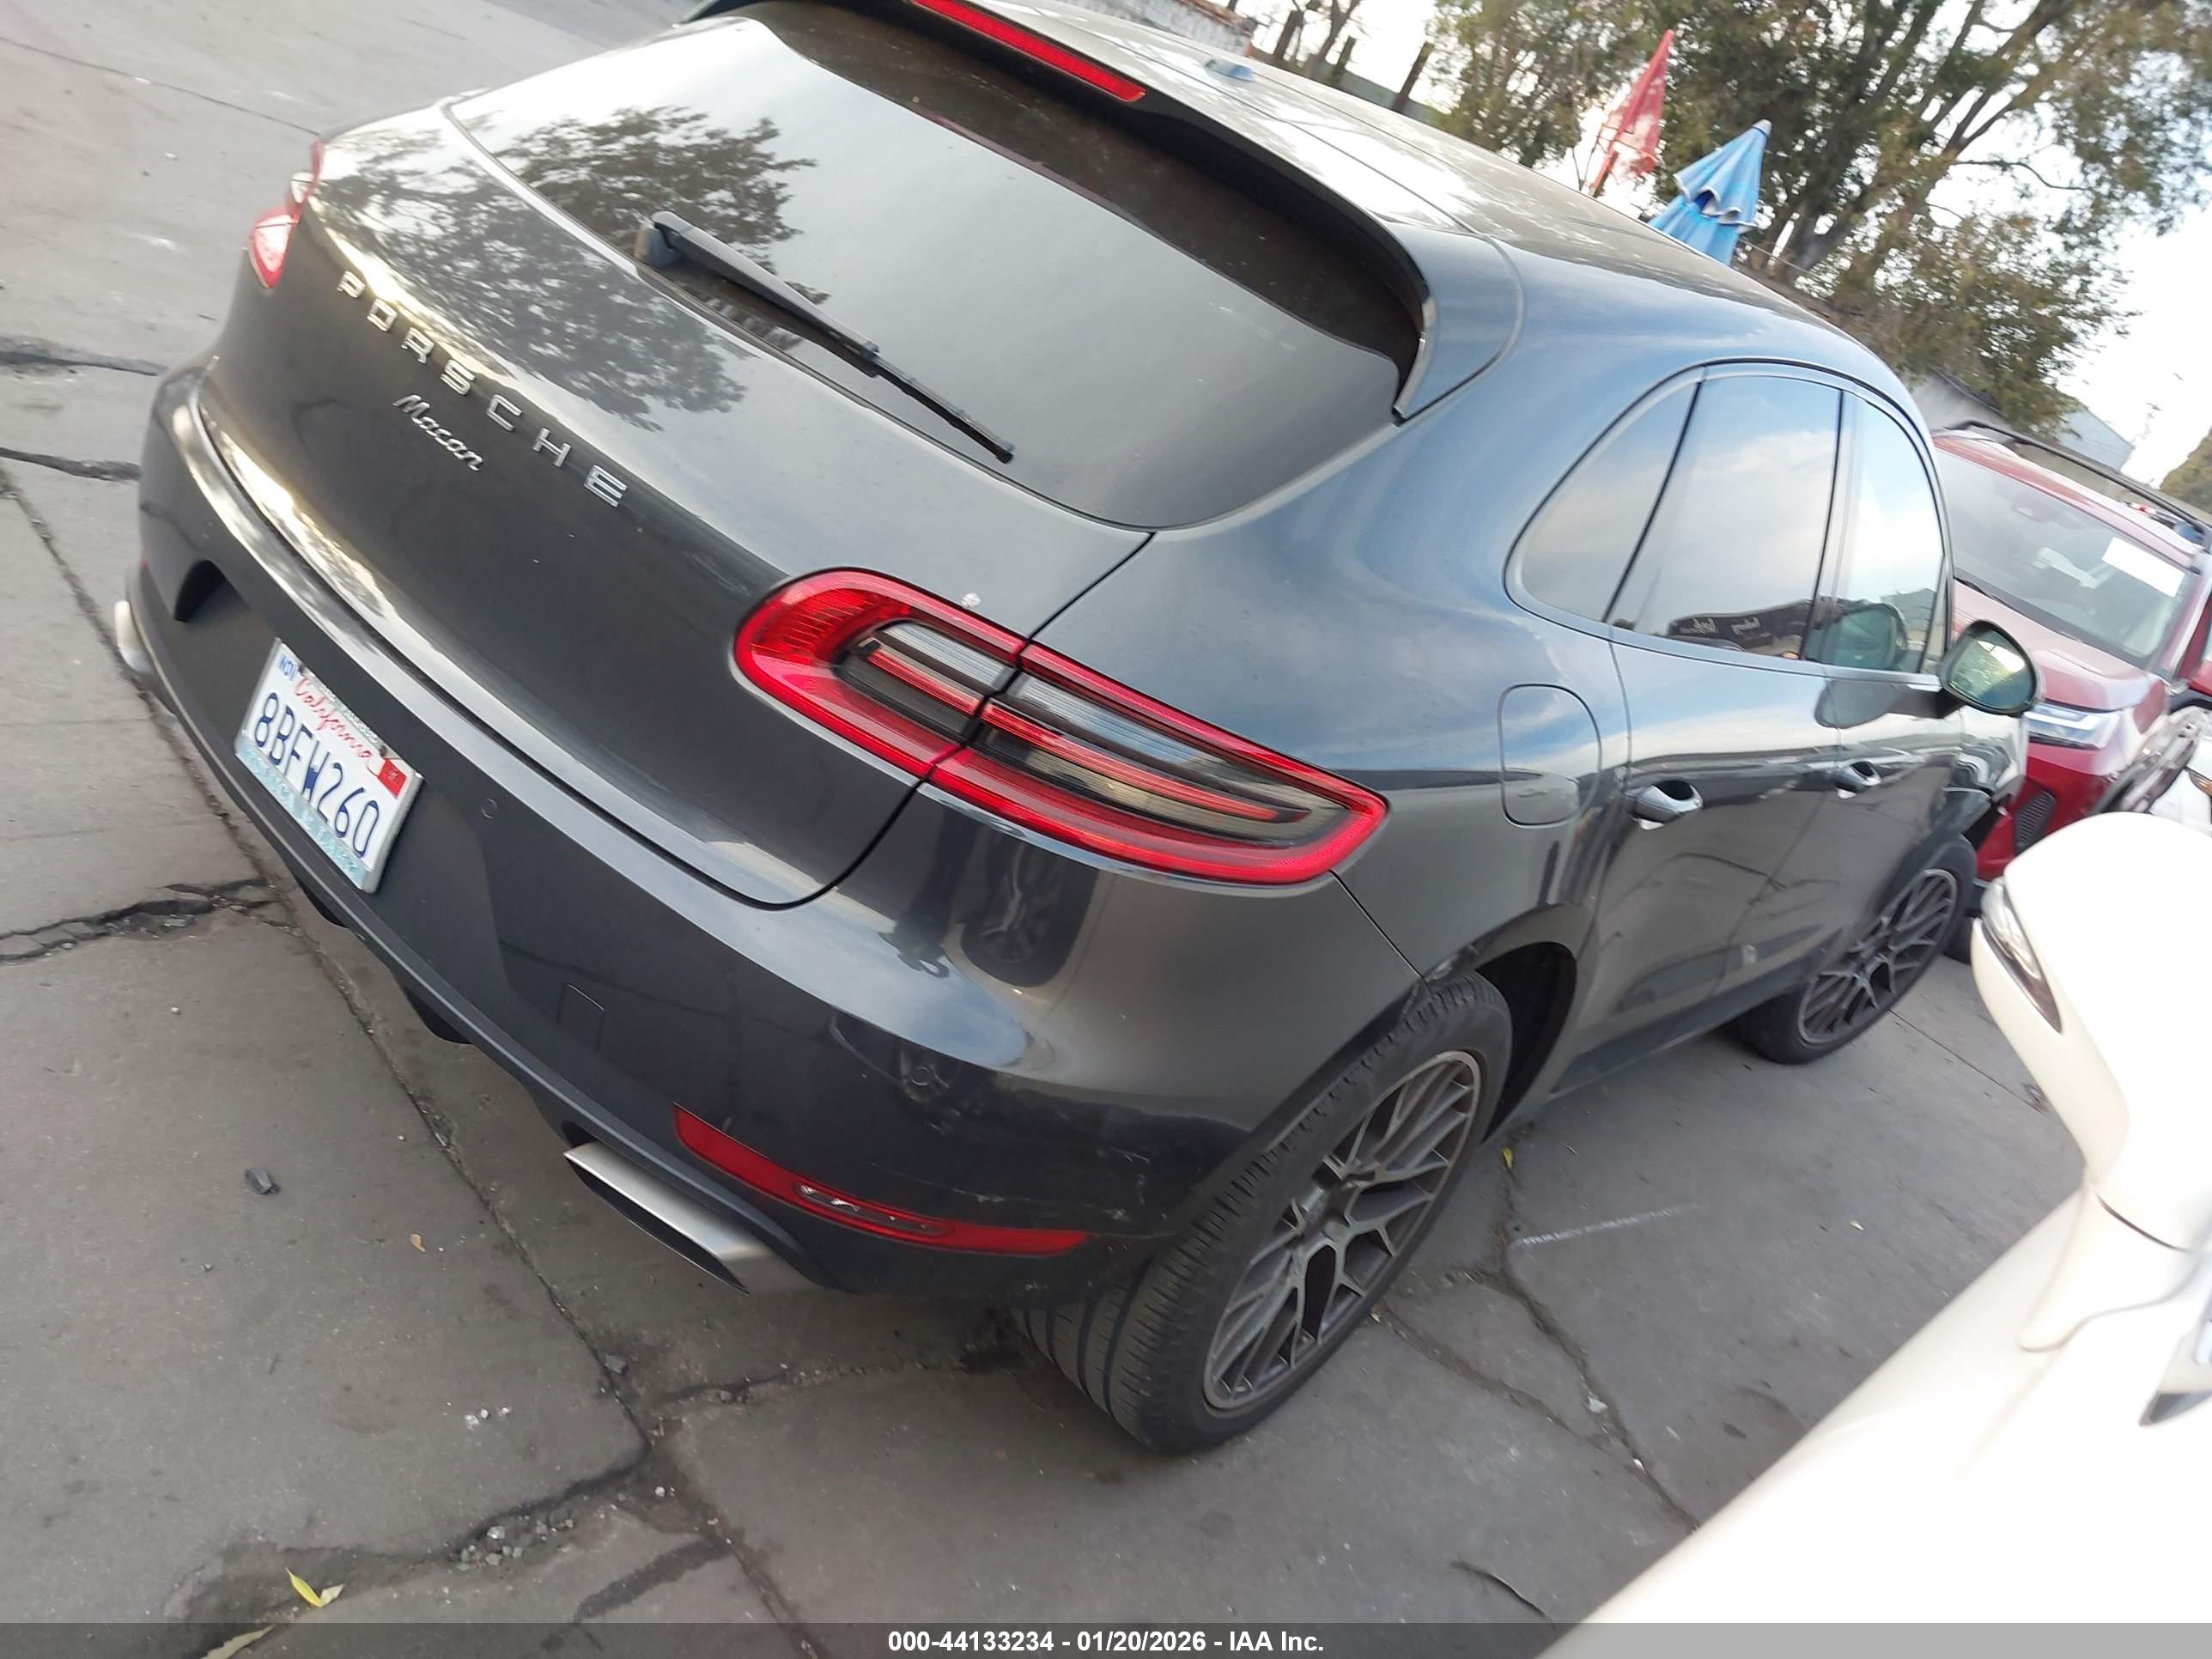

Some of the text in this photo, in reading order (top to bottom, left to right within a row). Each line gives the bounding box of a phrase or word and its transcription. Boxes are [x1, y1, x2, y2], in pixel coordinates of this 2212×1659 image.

[337, 270, 628, 507] PORSCHE
[392, 394, 484, 471] Macan
[253, 691, 380, 859] 8BFW260
[294, 676, 374, 763] California
